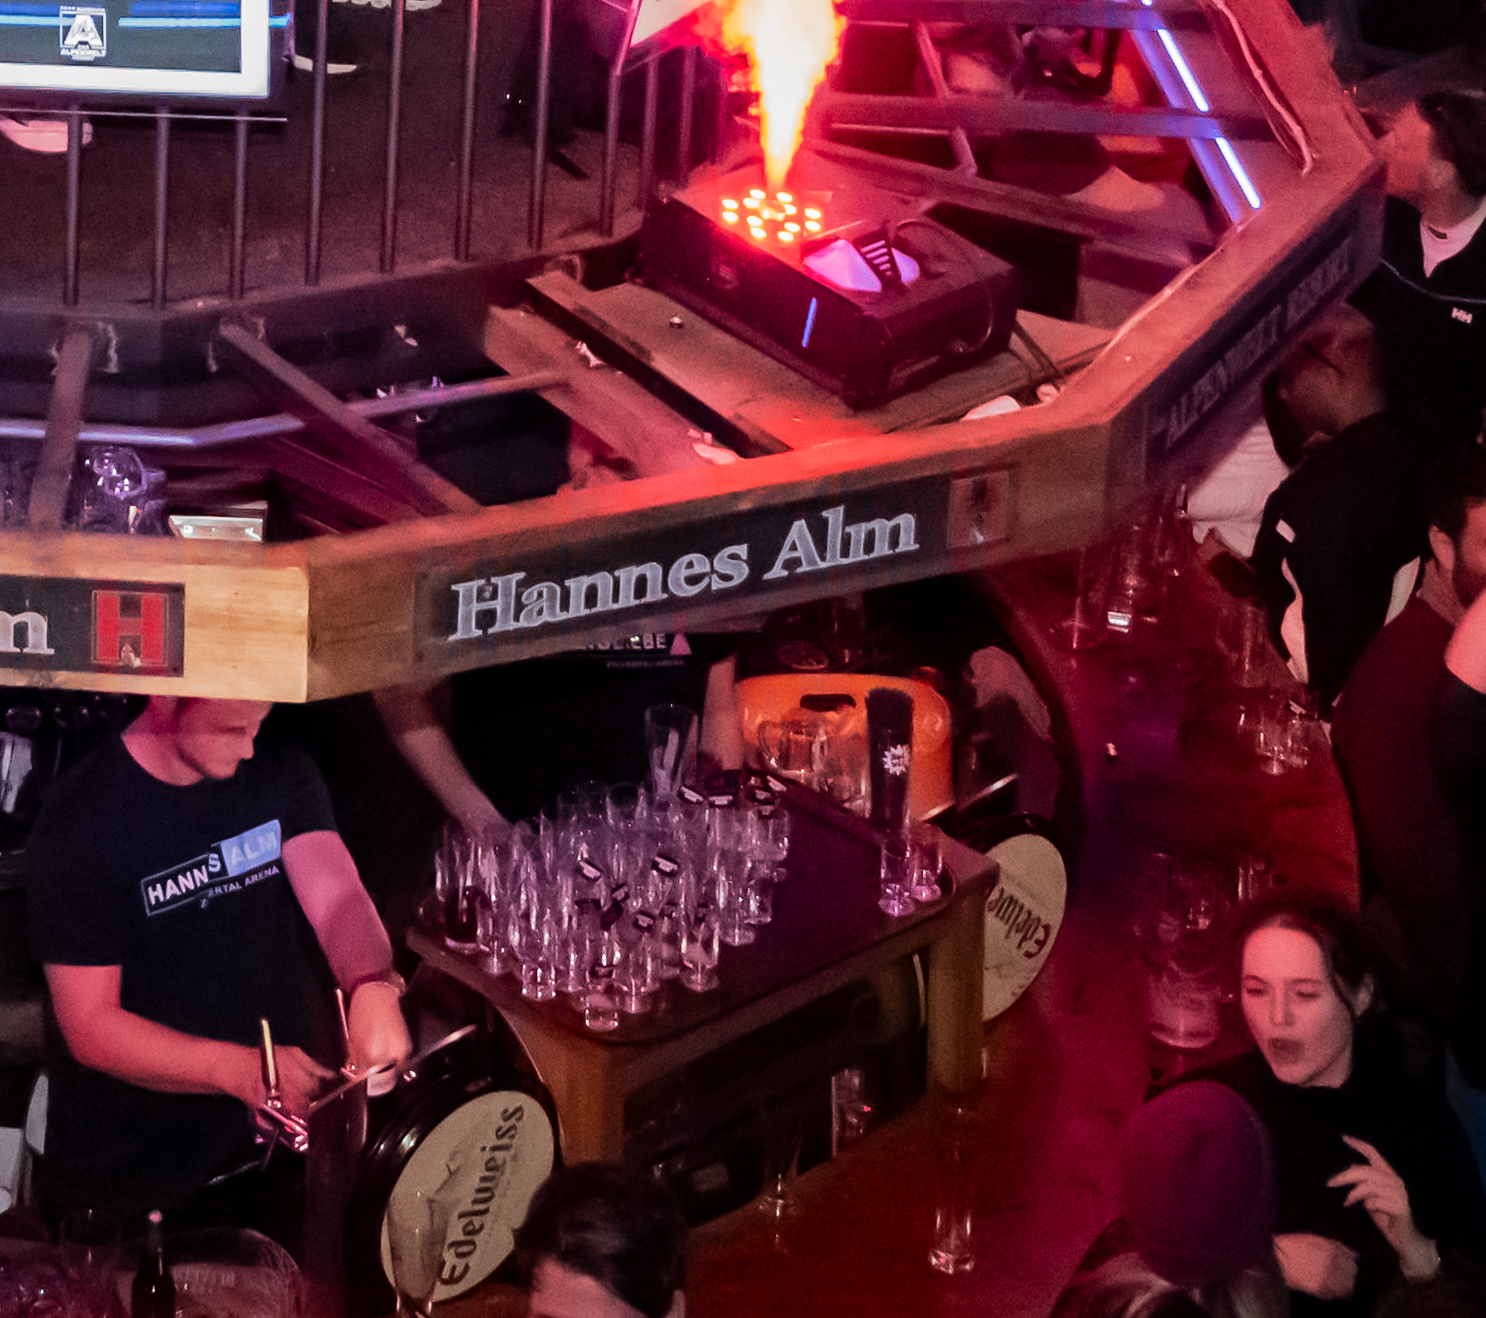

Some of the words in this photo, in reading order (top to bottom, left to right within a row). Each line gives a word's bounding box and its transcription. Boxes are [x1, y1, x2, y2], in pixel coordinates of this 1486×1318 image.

[446, 548, 750, 643] Hannes
[760, 504, 922, 582] Alm
[147, 853, 221, 906] HANNS
[231, 831, 278, 866] ALM
[244, 865, 280, 887] ARENA
[439, 1102, 525, 1287] Edelweiss
